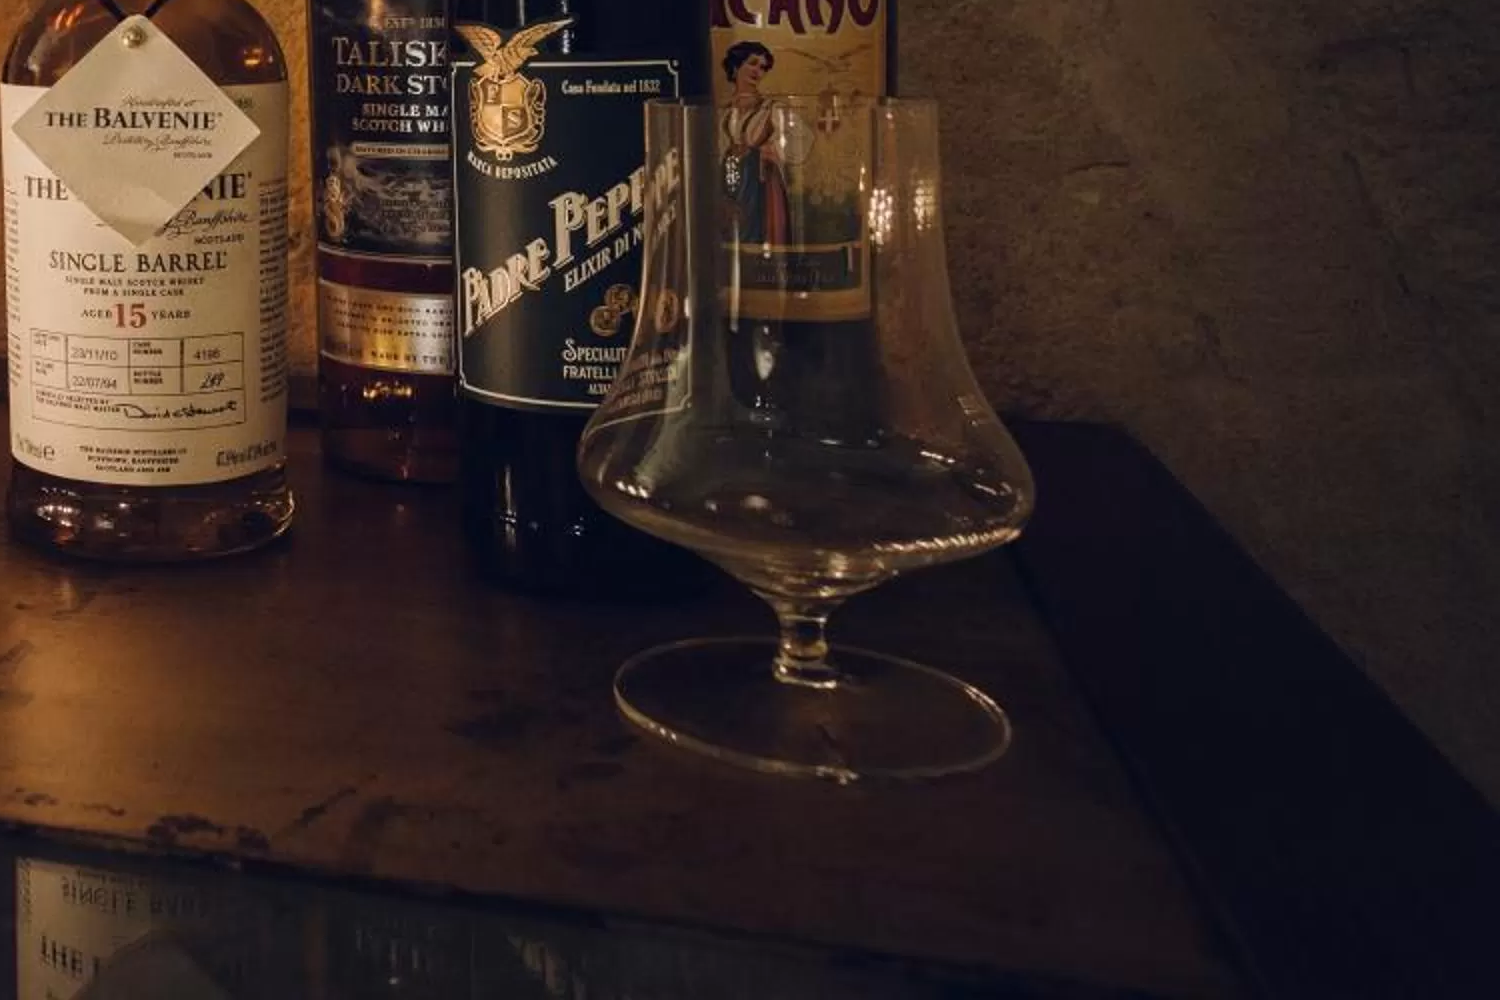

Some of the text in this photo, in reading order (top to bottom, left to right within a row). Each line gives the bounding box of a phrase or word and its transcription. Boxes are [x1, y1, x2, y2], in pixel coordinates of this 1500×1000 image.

[335, 73, 403, 96] DARK
[44, 107, 217, 130] THE BALVENIE
[361, 103, 420, 118] SINGLE
[24, 175, 69, 201] THE
[49, 251, 227, 273] SINGLE BARREL
[563, 231, 630, 293] ELIXIR DI
[462, 237, 551, 338] PADRE
[80, 302, 192, 329] AGED 15 YEARS
